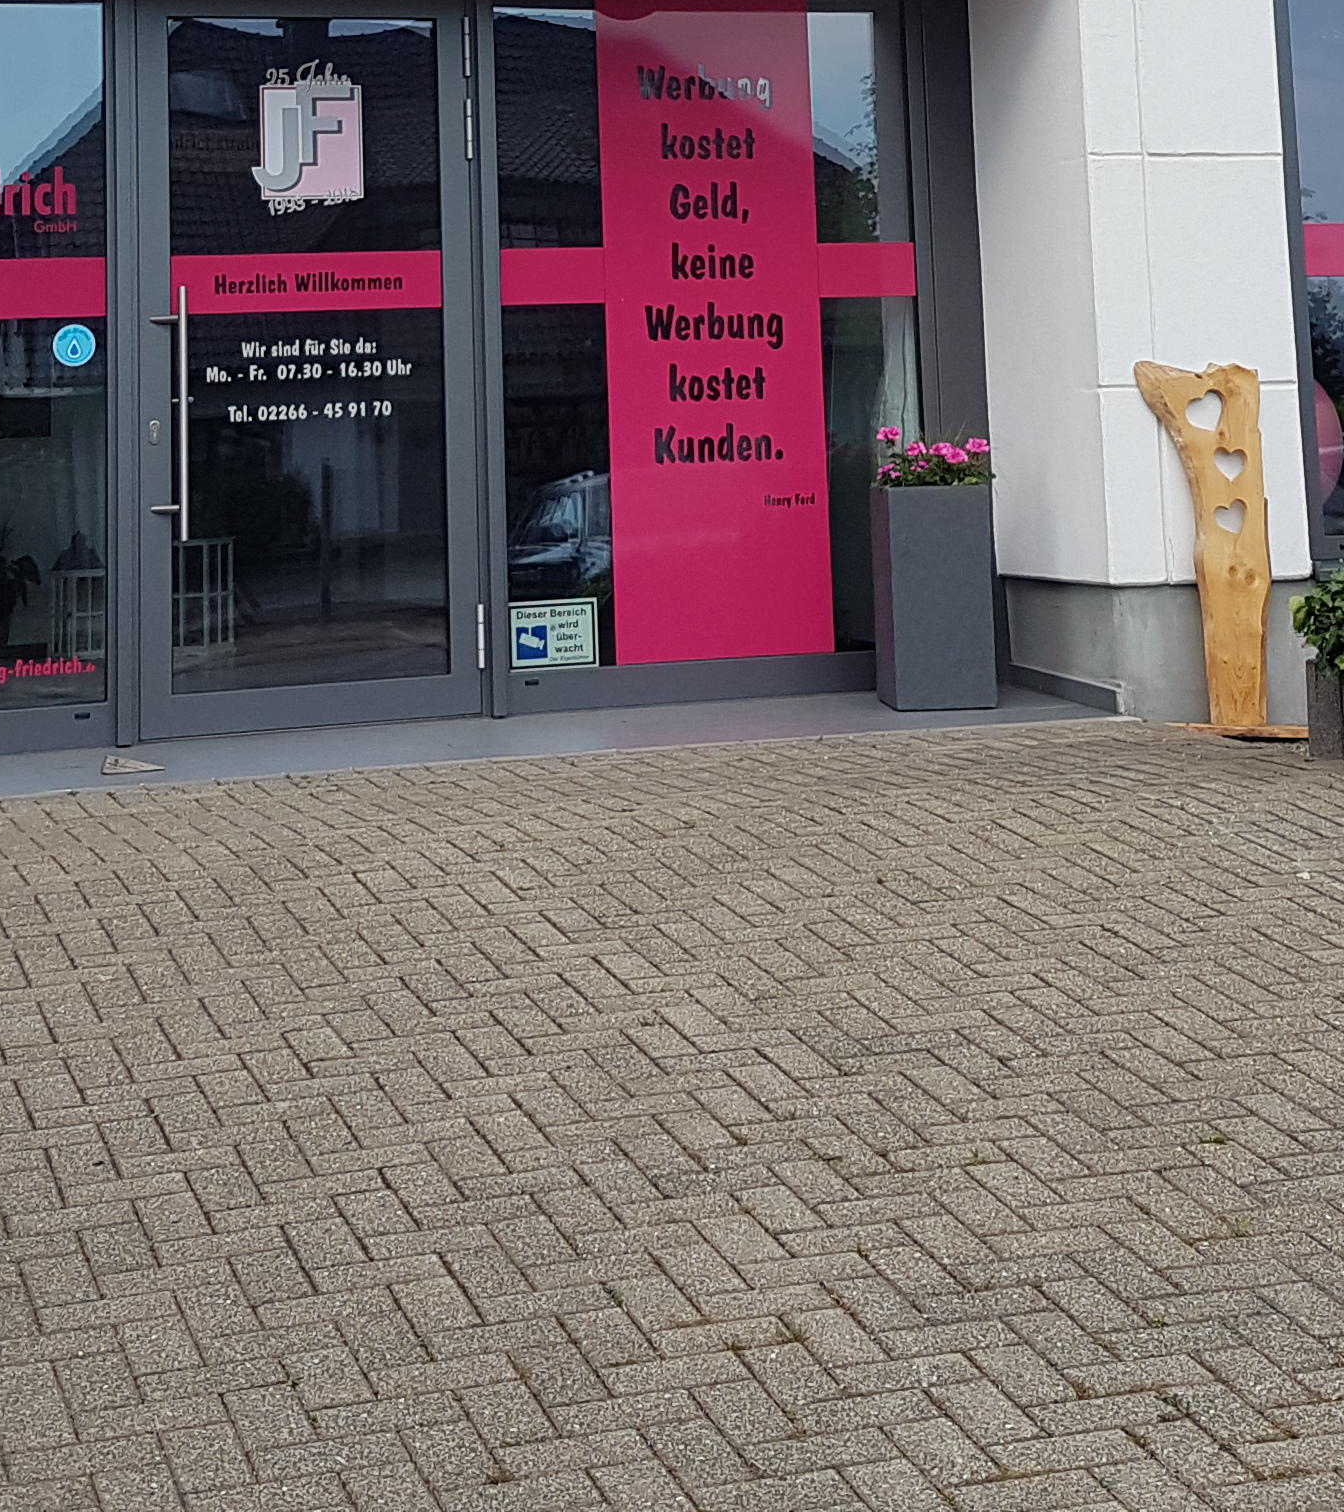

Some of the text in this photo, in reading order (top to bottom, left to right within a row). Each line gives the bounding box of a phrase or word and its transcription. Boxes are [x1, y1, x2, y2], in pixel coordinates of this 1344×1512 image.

[265, 68, 290, 86] 25
[636, 64, 774, 109] Werbung
[660, 122, 756, 162] kostet
[268, 196, 306, 217] 1993
[668, 181, 750, 225] Geld,
[33, 220, 77, 234] GmbH
[669, 241, 755, 281] keine
[213, 271, 403, 295] Herzlich Willkommen
[644, 303, 785, 349] Werbung
[241, 337, 377, 358] Wir sind für Sie da:
[206, 366, 232, 383] Mo.
[249, 364, 267, 381] Fr.
[277, 363, 322, 380] 07.30
[340, 361, 382, 377] 16.30
[387, 358, 412, 375] Uhr
[669, 363, 766, 402] kostet
[228, 404, 253, 422] Tel.
[258, 403, 307, 421] 02266
[323, 402, 343, 419] 45
[348, 401, 366, 418] 91
[373, 400, 392, 416] 70
[654, 424, 784, 466] Kunden.
[516, 608, 587, 620] Dieser Bereich
[558, 620, 579, 629] wird
[555, 644, 584, 653] wacht
